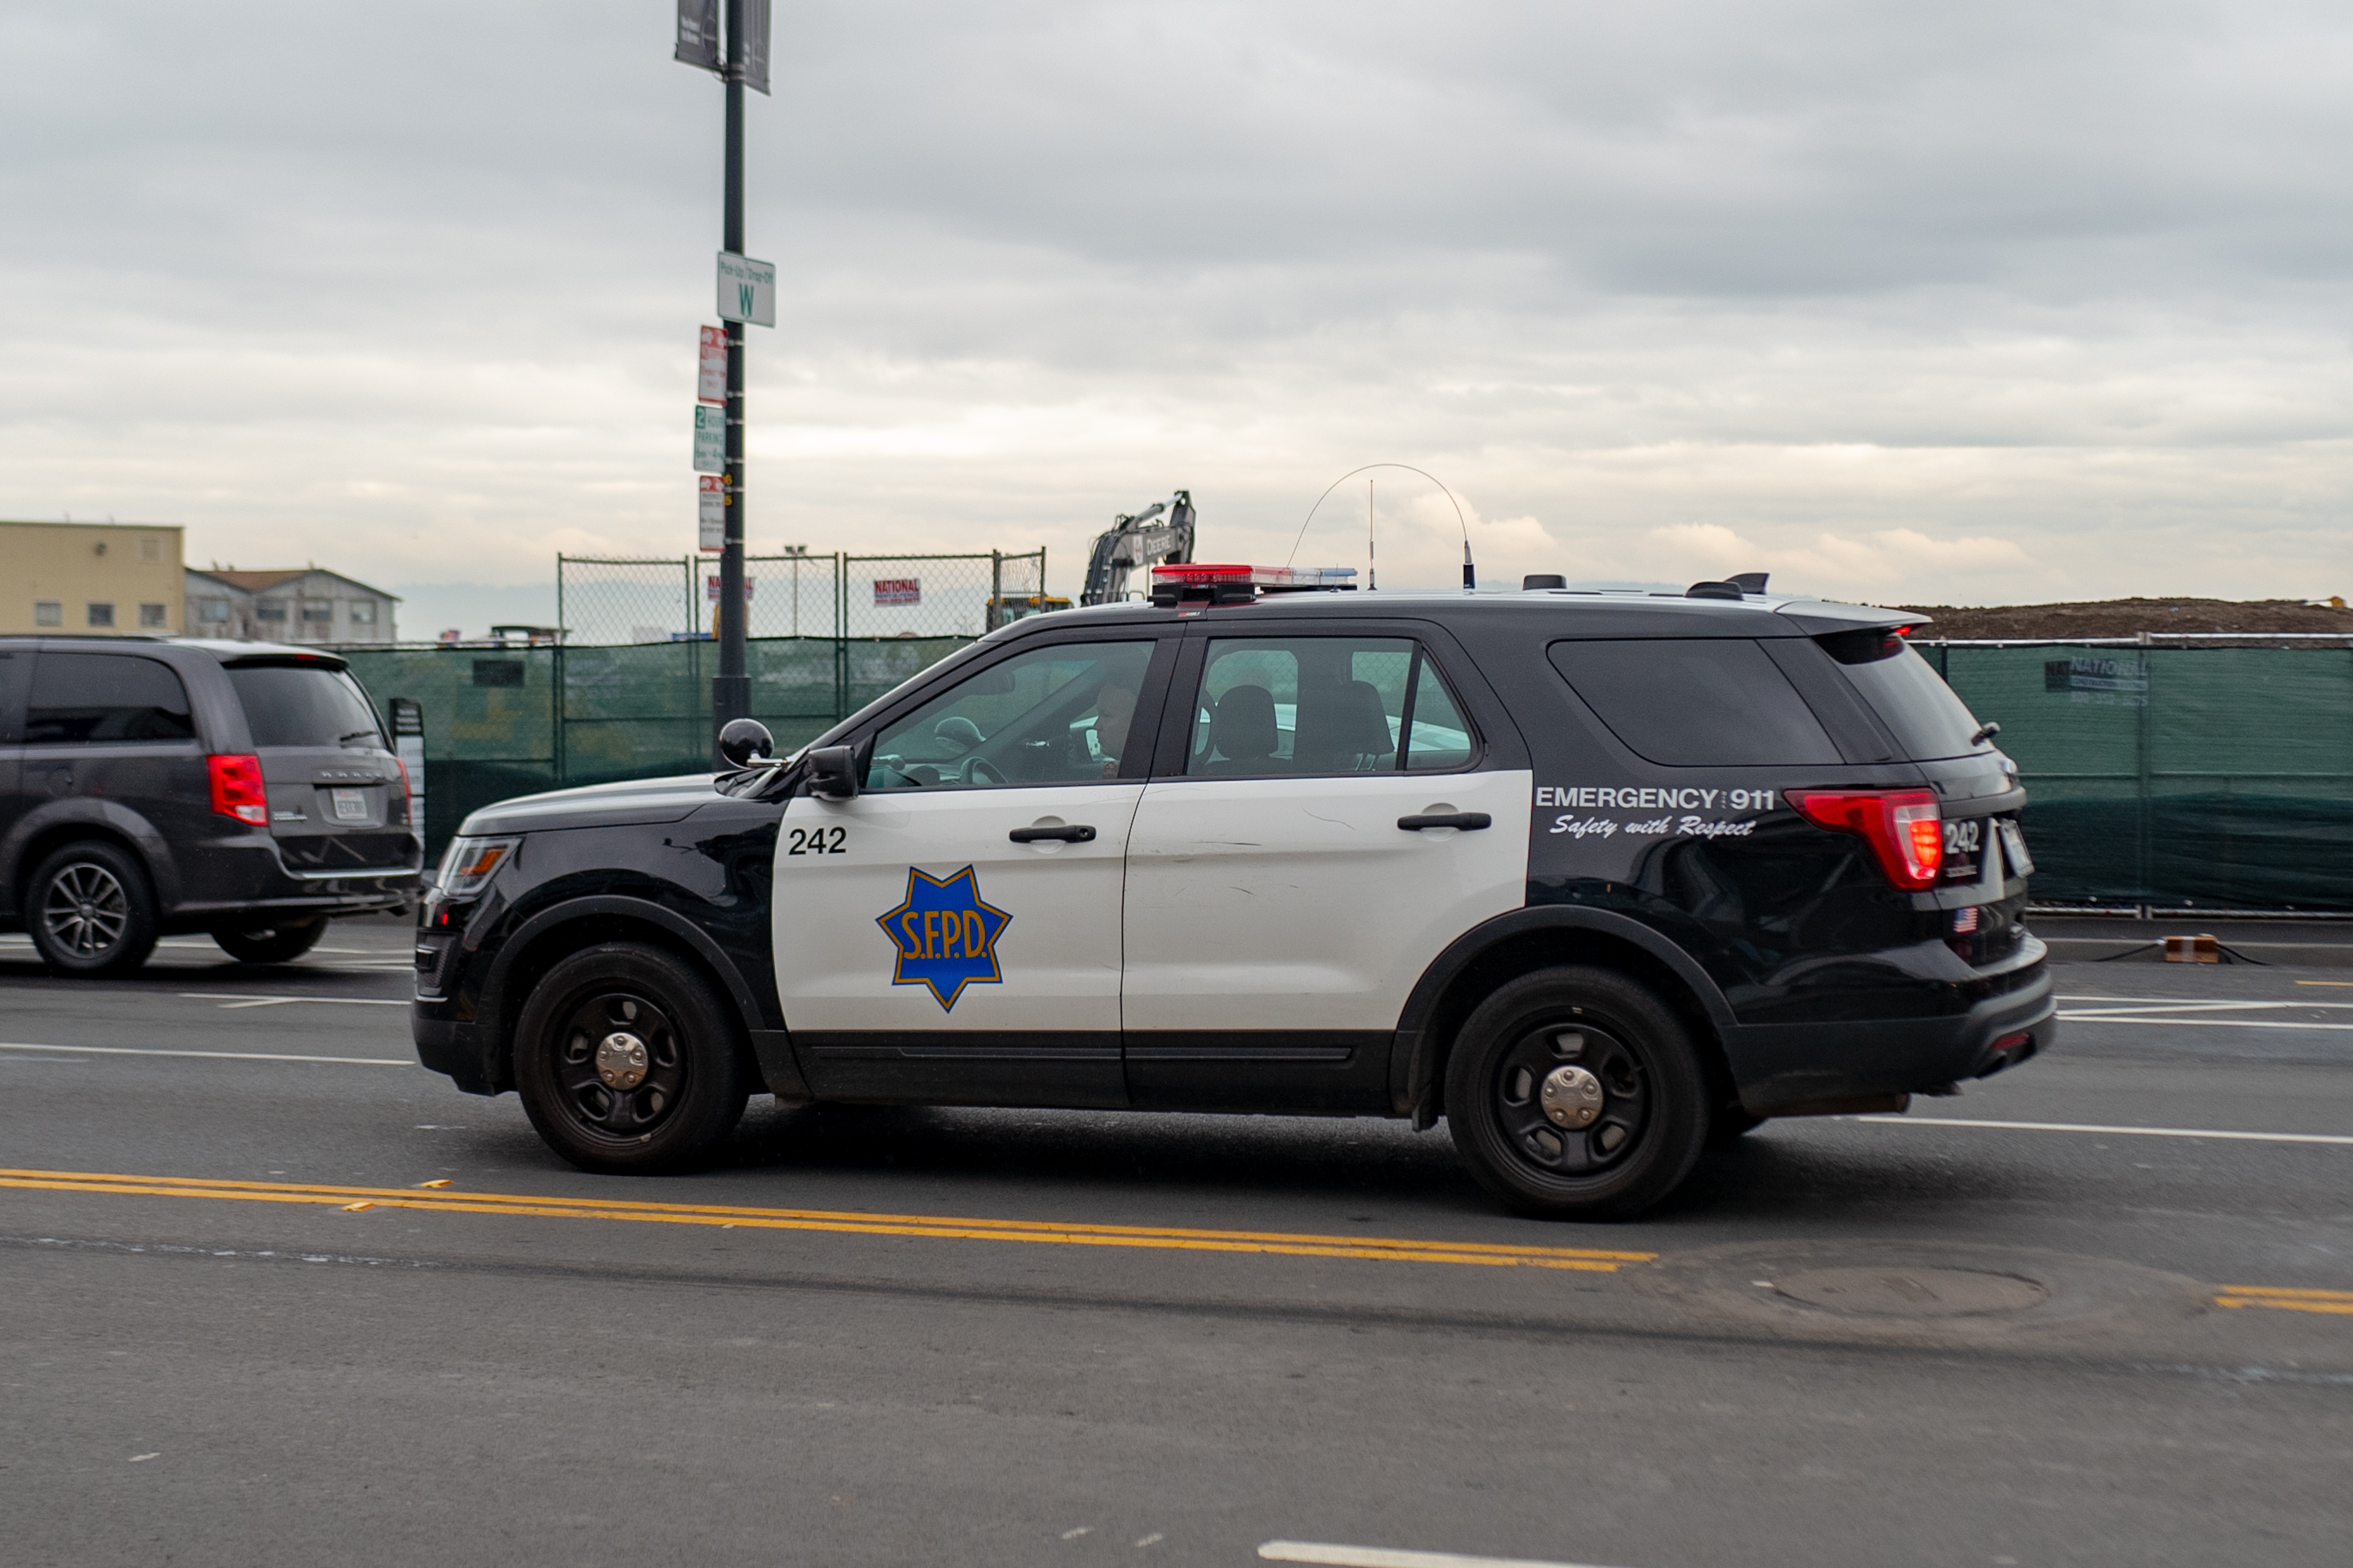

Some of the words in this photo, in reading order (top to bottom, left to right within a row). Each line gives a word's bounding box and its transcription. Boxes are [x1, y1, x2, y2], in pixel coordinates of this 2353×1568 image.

[738, 283, 754, 316] W
[697, 408, 704, 427] 2
[1147, 535, 1171, 556] DEERE
[876, 580, 920, 593] NATIONAL
[1536, 787, 1719, 809] EMERGENCY
[1730, 790, 1774, 810] 911
[1550, 815, 1618, 839] Safety
[1625, 816, 1672, 835] with
[1675, 816, 1757, 840] Respect
[1945, 821, 1980, 854] 242
[789, 826, 846, 855] 242
[901, 910, 987, 959] S.F.P.D.
